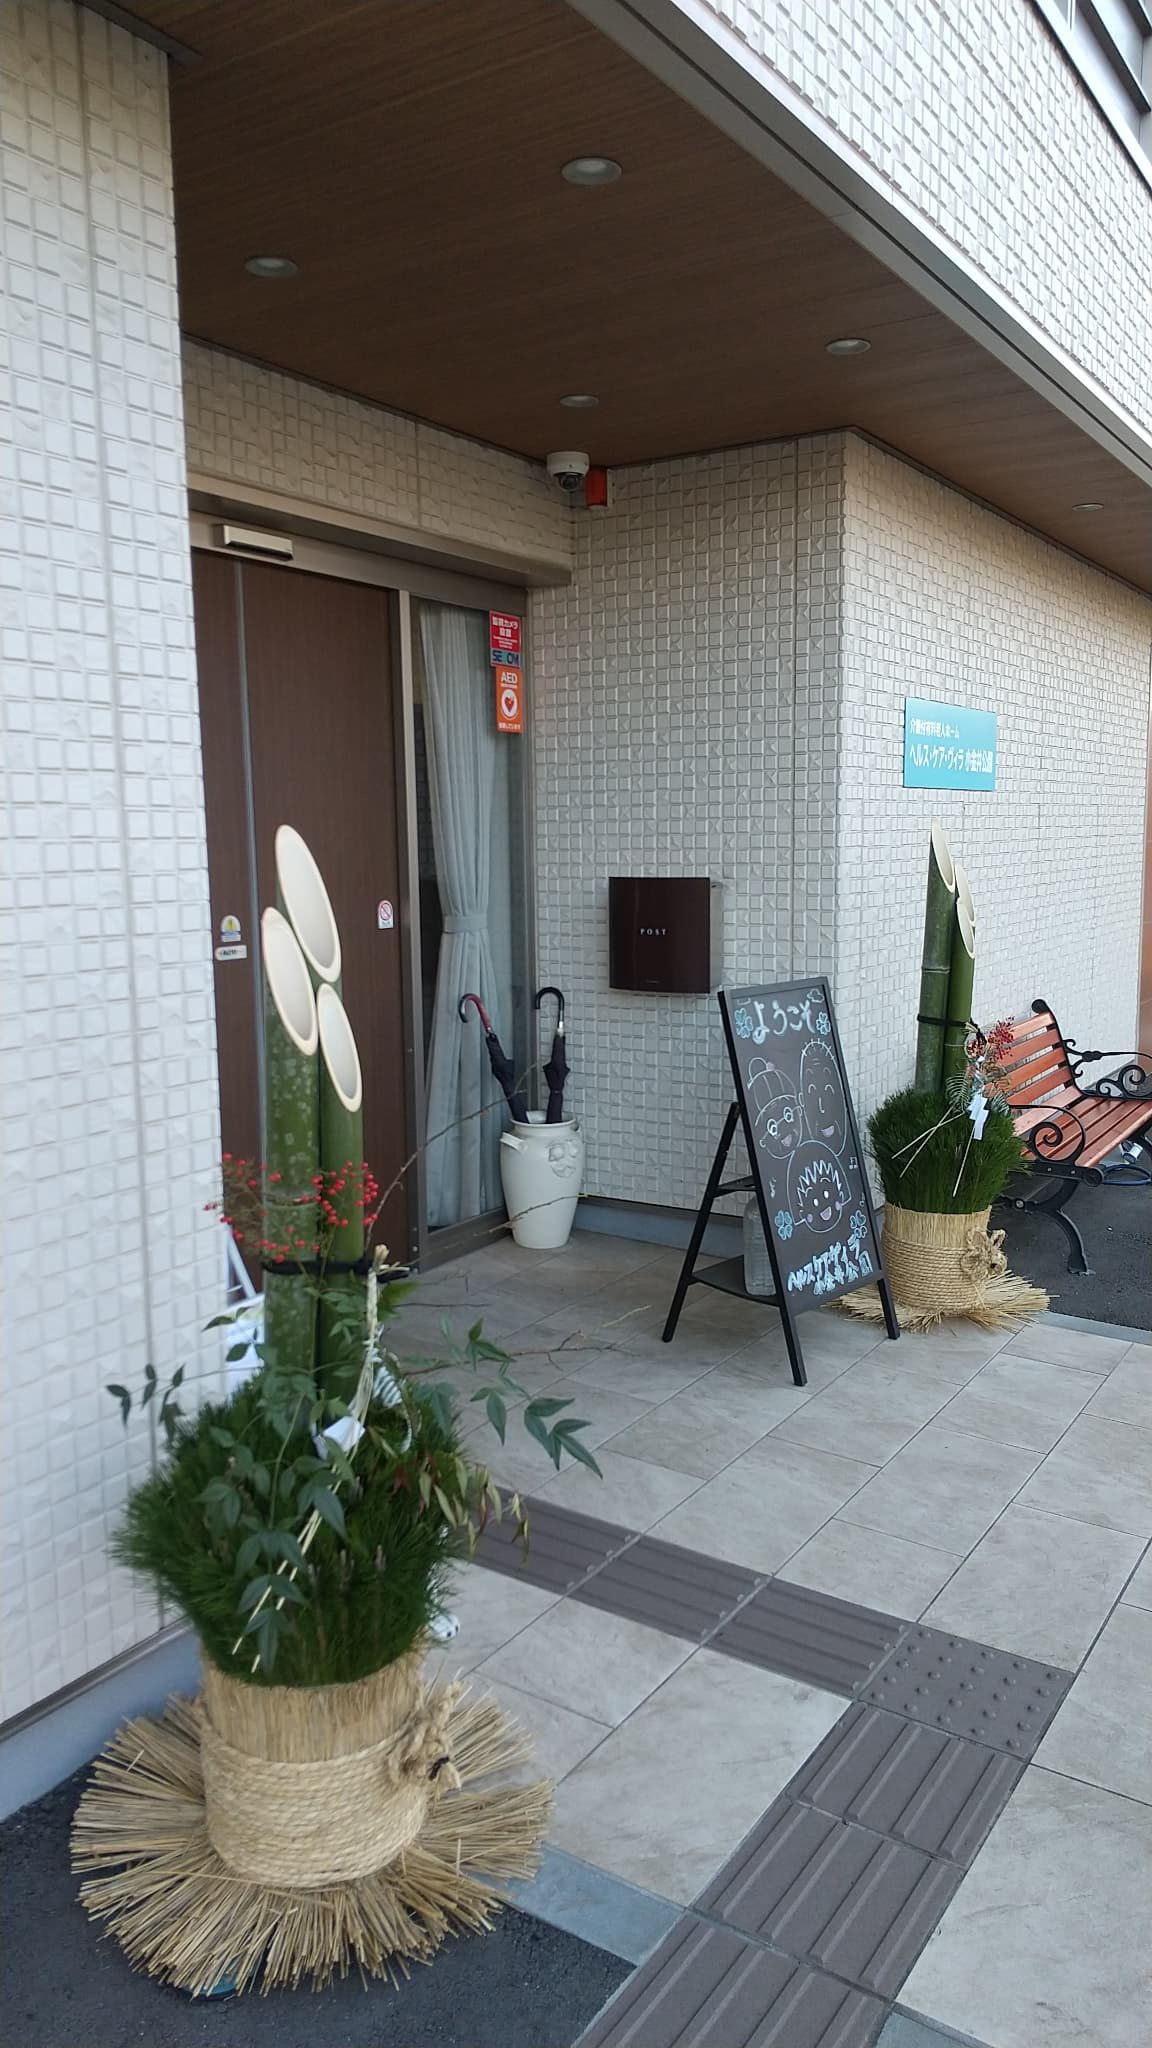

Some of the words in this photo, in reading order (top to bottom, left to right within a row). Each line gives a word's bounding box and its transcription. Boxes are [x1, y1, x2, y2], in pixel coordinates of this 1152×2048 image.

[501, 672, 518, 684] AED
[640, 928, 667, 936] POST
[752, 1000, 815, 1044] ようこそ
